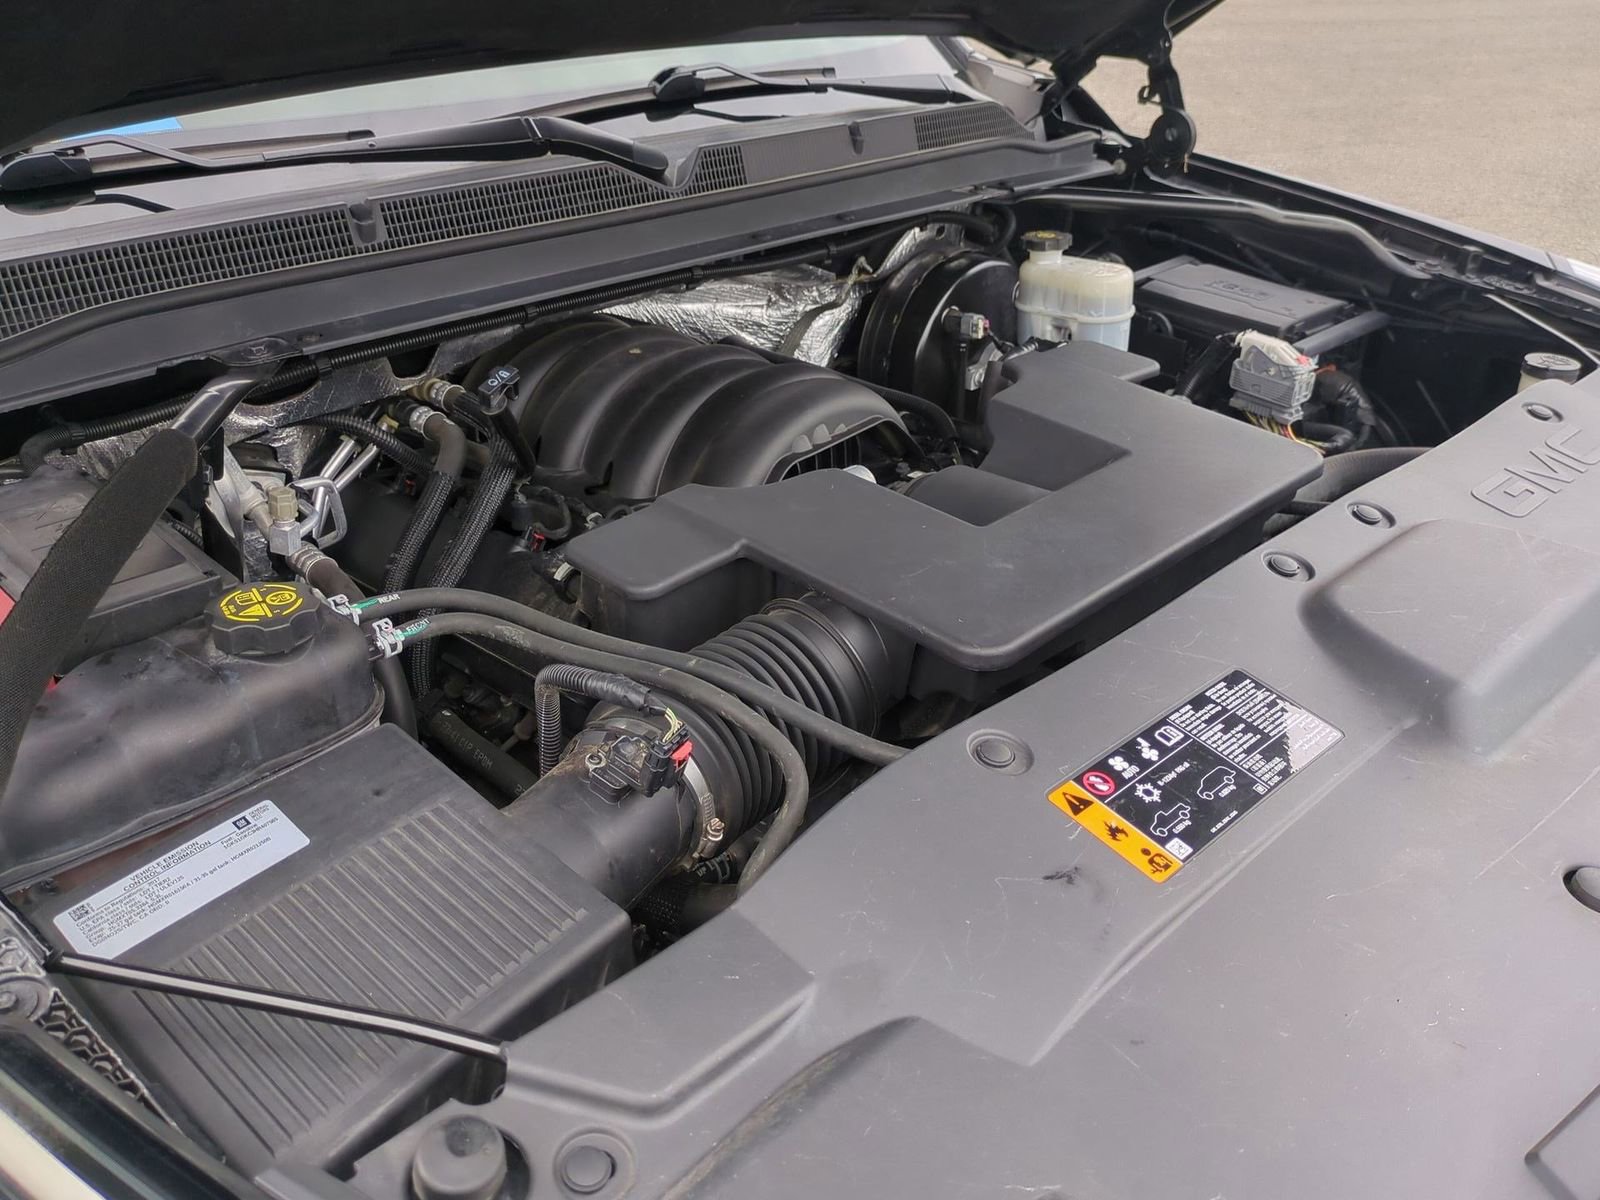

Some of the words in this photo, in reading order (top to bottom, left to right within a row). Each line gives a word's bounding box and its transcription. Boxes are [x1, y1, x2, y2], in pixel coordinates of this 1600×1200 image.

[1470, 424, 1600, 518] GMC
[378, 593, 401, 605] REAR
[1121, 765, 1140, 779] AUTO
[123, 870, 160, 892] CONTROL
[161, 841, 211, 870] INFORMATION
[130, 861, 163, 881] VEHICLE
[163, 841, 199, 863] EMISSION
[76, 910, 104, 927] Conforms
[82, 918, 110, 935] California
[92, 916, 104, 924] EPA
